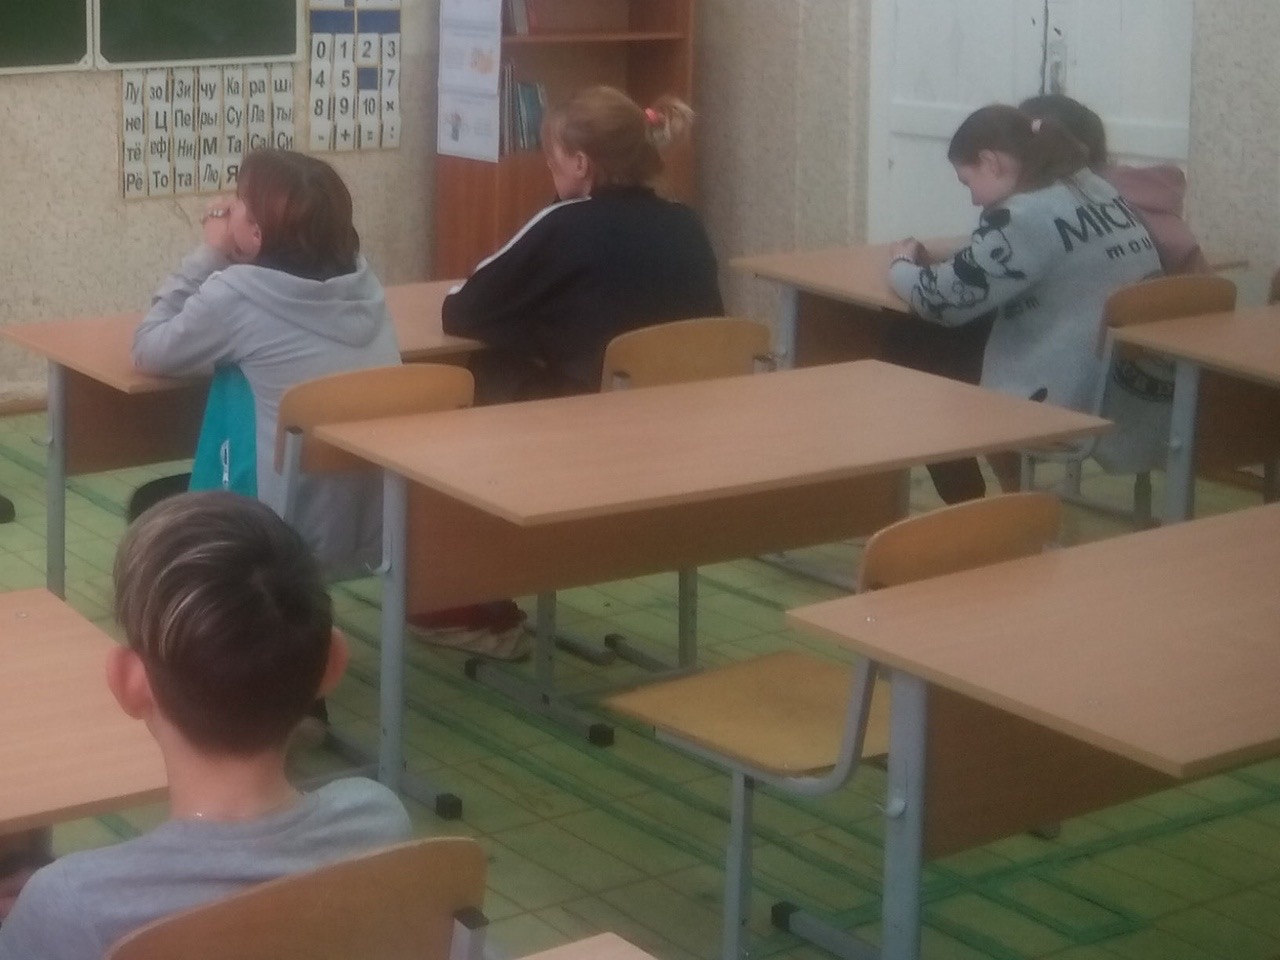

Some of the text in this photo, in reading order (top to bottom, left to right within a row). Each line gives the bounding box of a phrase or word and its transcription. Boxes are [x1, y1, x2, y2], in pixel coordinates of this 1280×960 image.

[316, 40, 396, 59] 0 1 2 3
[201, 82, 216, 100] чу
[227, 76, 240, 95] Ка
[249, 80, 265, 98] ра
[315, 69, 396, 88] 4 5 7
[314, 98, 323, 116] 8
[340, 97, 349, 115] 9
[363, 97, 376, 115] 10
[155, 110, 168, 132] Ц
[174, 109, 191, 127] Пе
[200, 112, 217, 130] ры
[227, 104, 242, 129] Су
[250, 104, 265, 122] Ла
[203, 136, 218, 155] М
[227, 135, 242, 153] Та
[152, 170, 168, 188] То
[177, 172, 192, 187] та
[227, 165, 239, 183] Я
